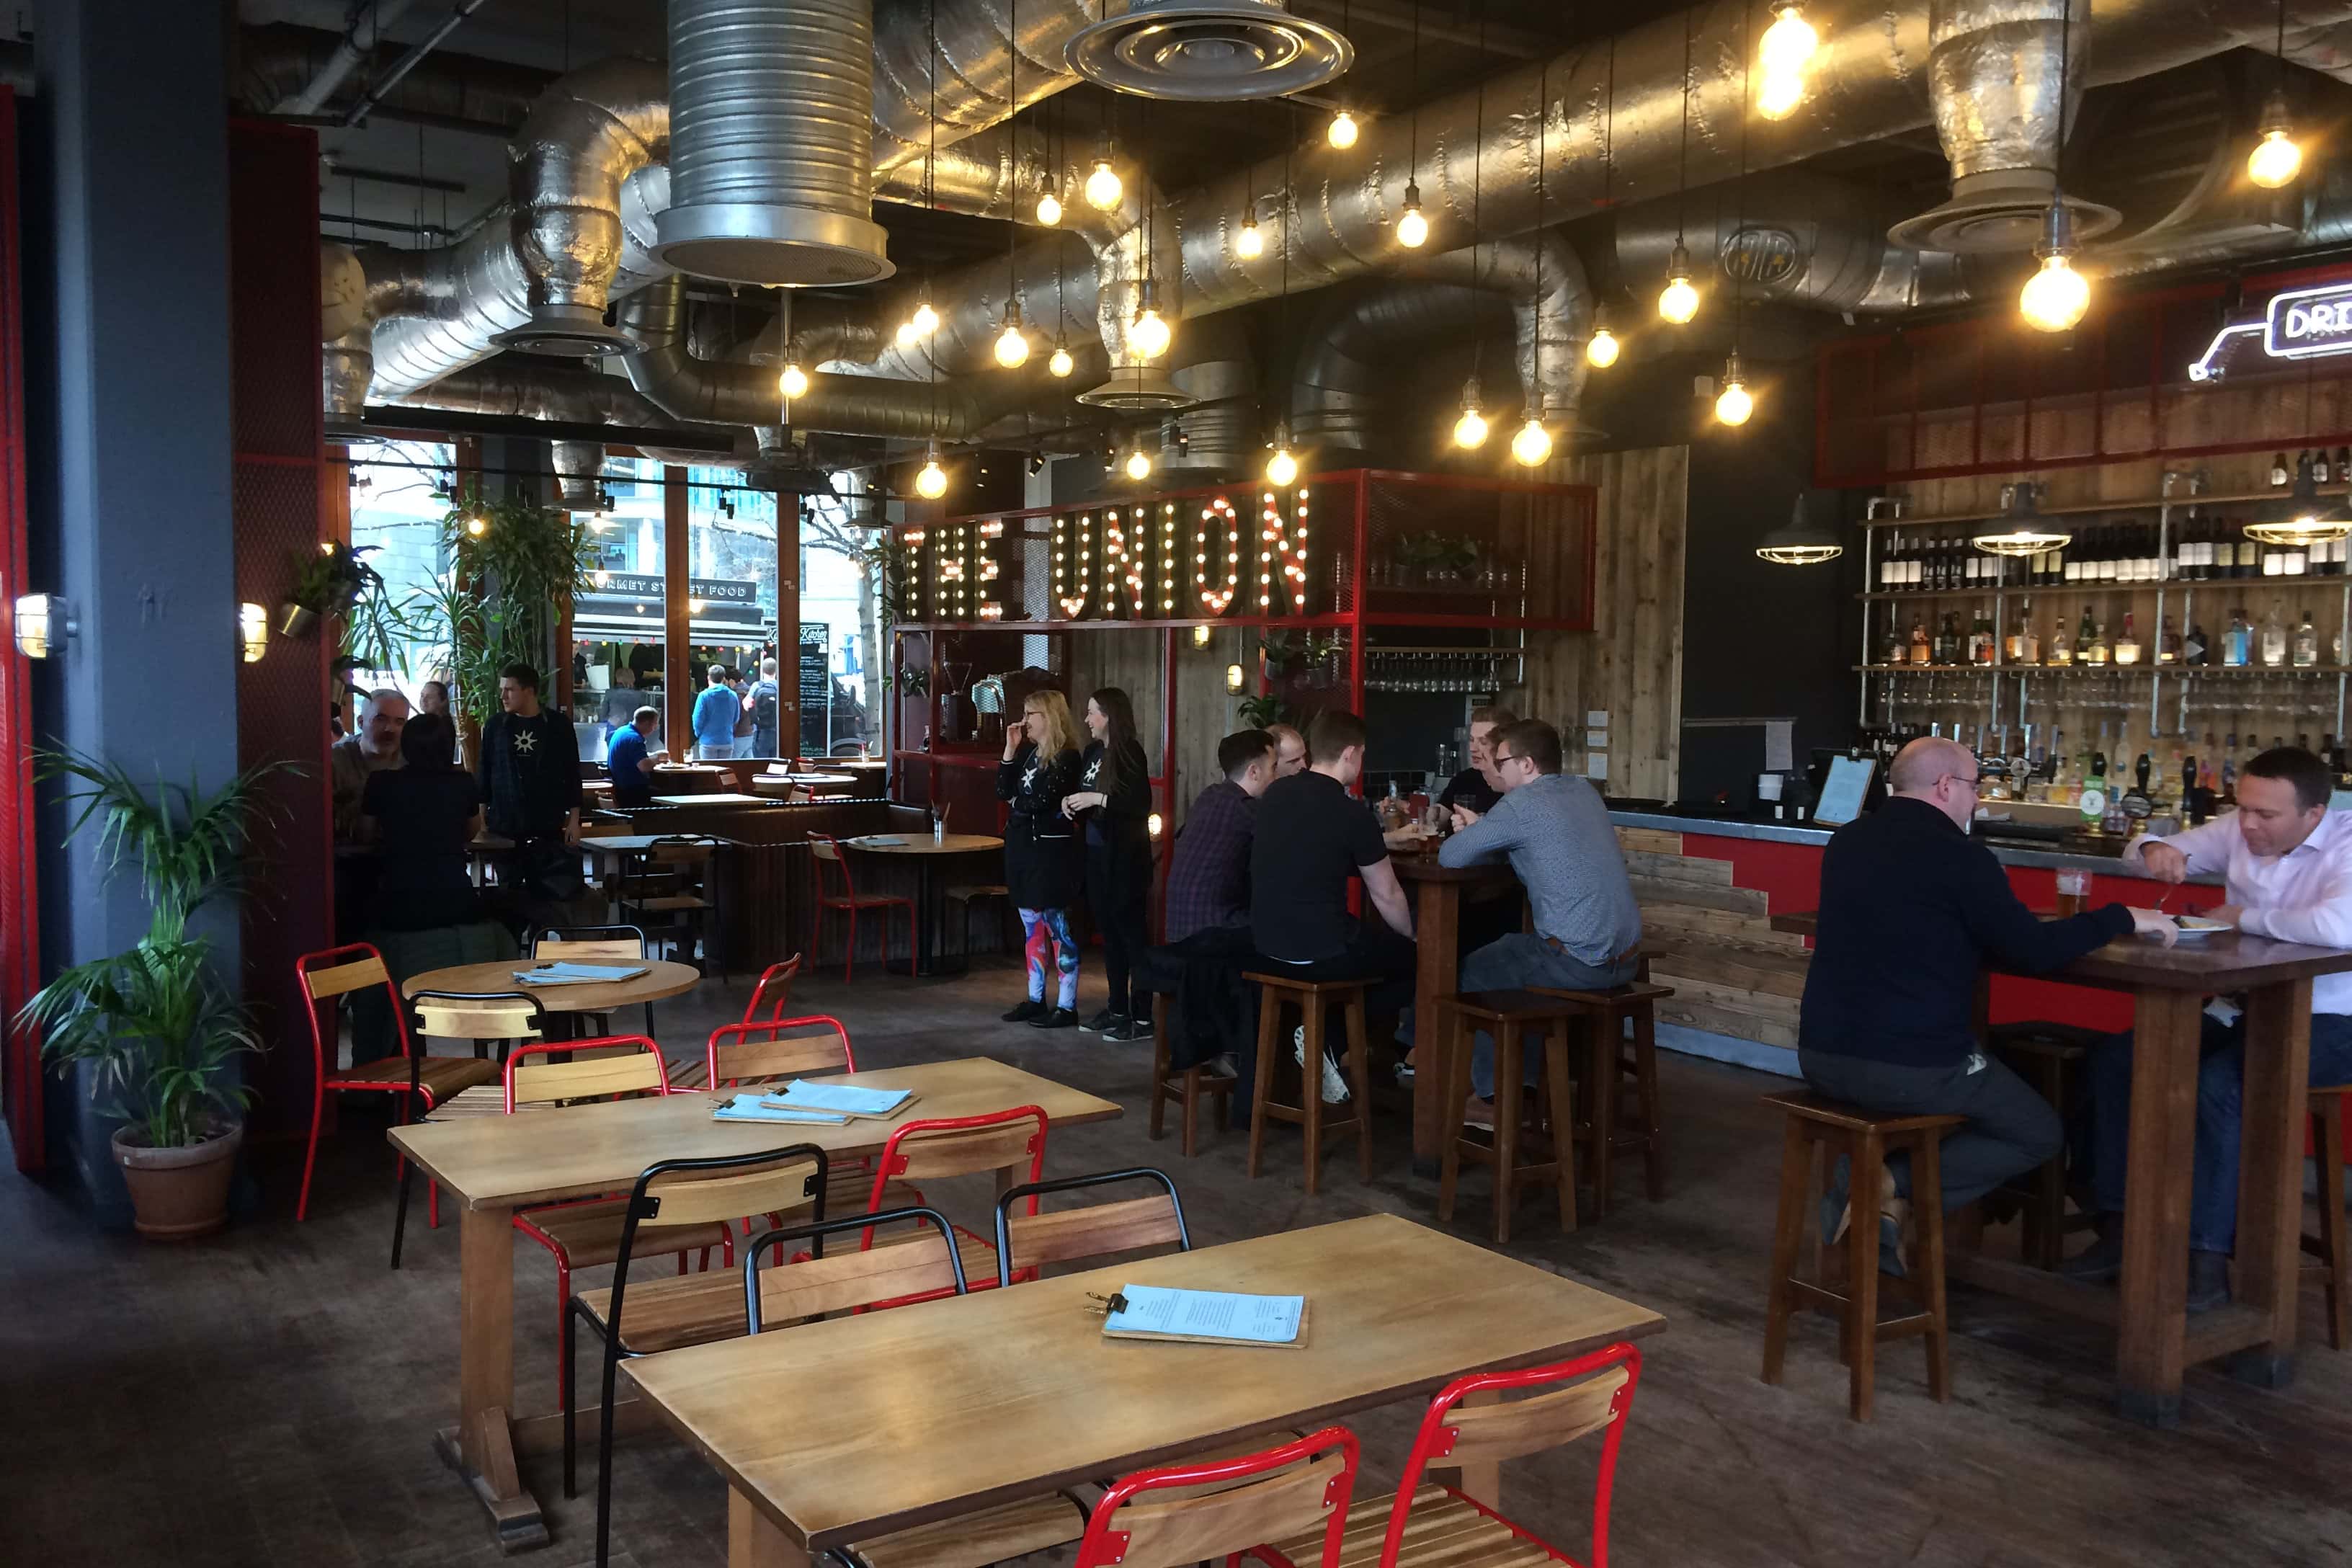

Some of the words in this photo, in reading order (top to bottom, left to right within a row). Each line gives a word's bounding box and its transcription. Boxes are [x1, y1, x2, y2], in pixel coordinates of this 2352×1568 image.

[579, 576, 646, 591] RMET
[650, 581, 704, 594] STET
[709, 585, 747, 597] FOOD
[902, 519, 1003, 622] THE
[1051, 485, 1310, 620] UNION
